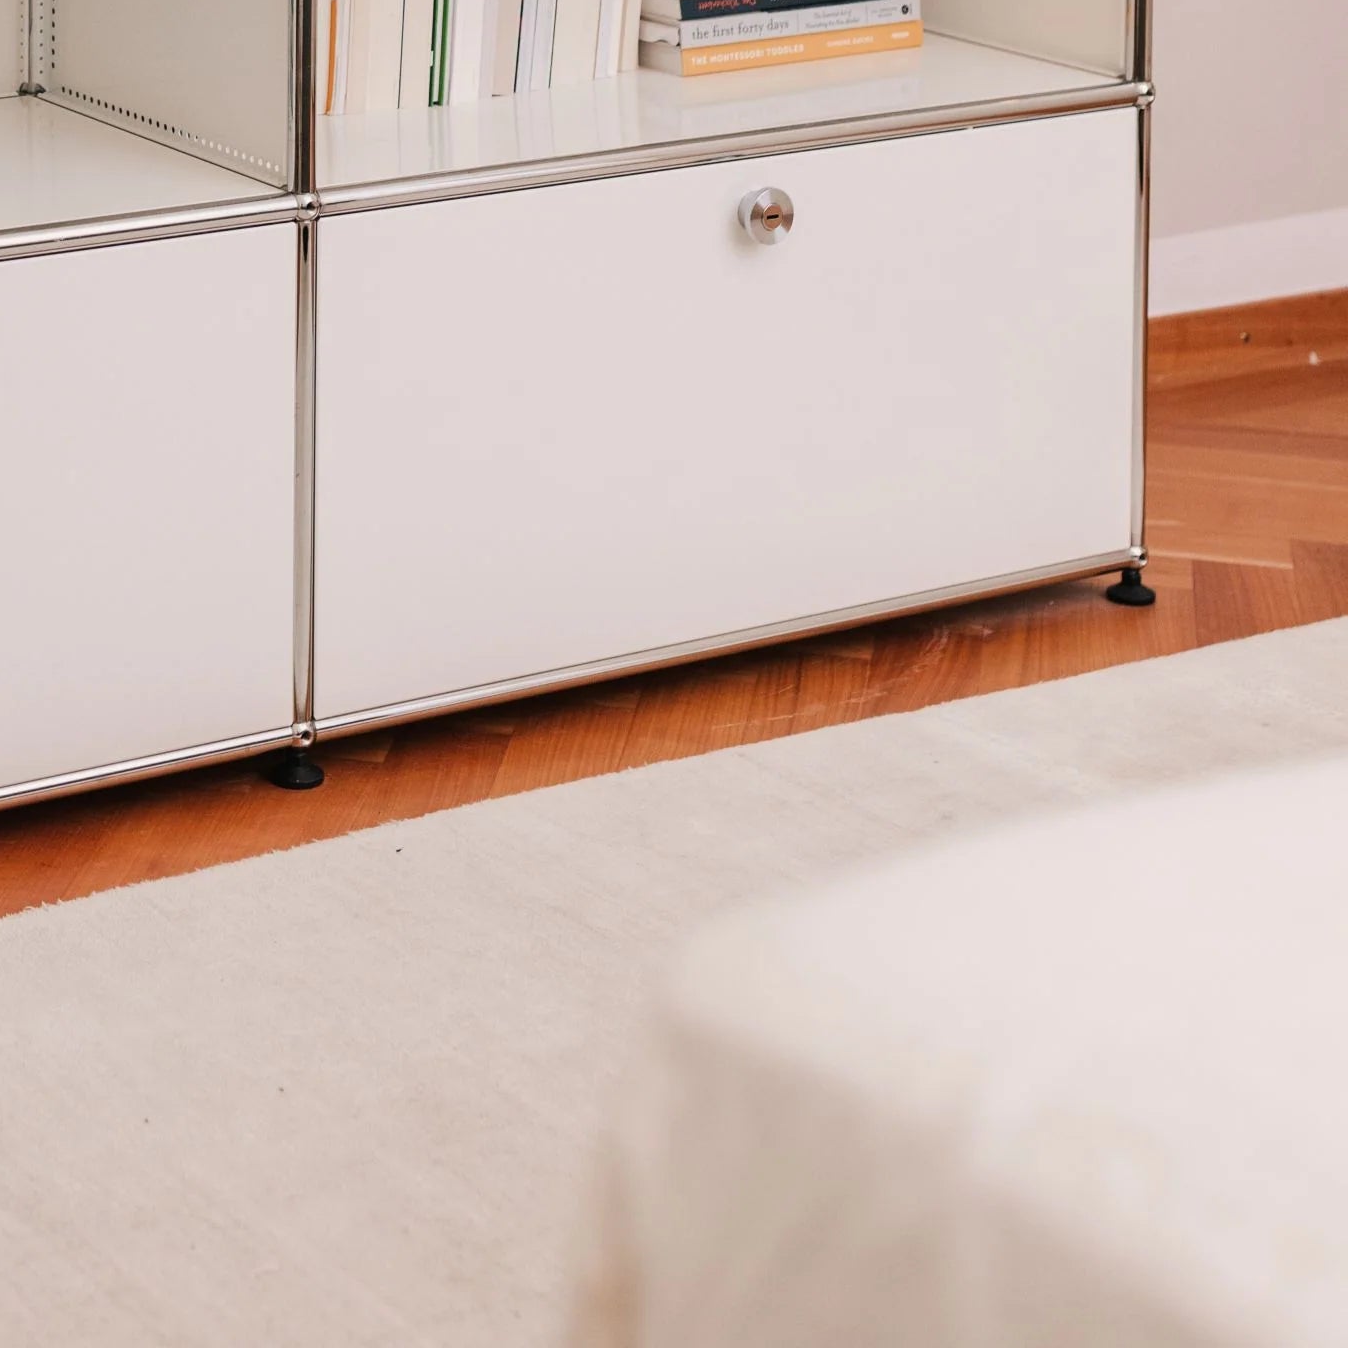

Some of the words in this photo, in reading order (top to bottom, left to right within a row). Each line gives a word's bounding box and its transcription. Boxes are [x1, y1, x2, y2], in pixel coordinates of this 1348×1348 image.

[692, 28, 708, 40] the
[712, 25, 734, 37] first
[737, 22, 764, 37] forty
[766, 19, 789, 34] days
[692, 56, 707, 66] THE
[710, 51, 765, 64] MONTESSORI
